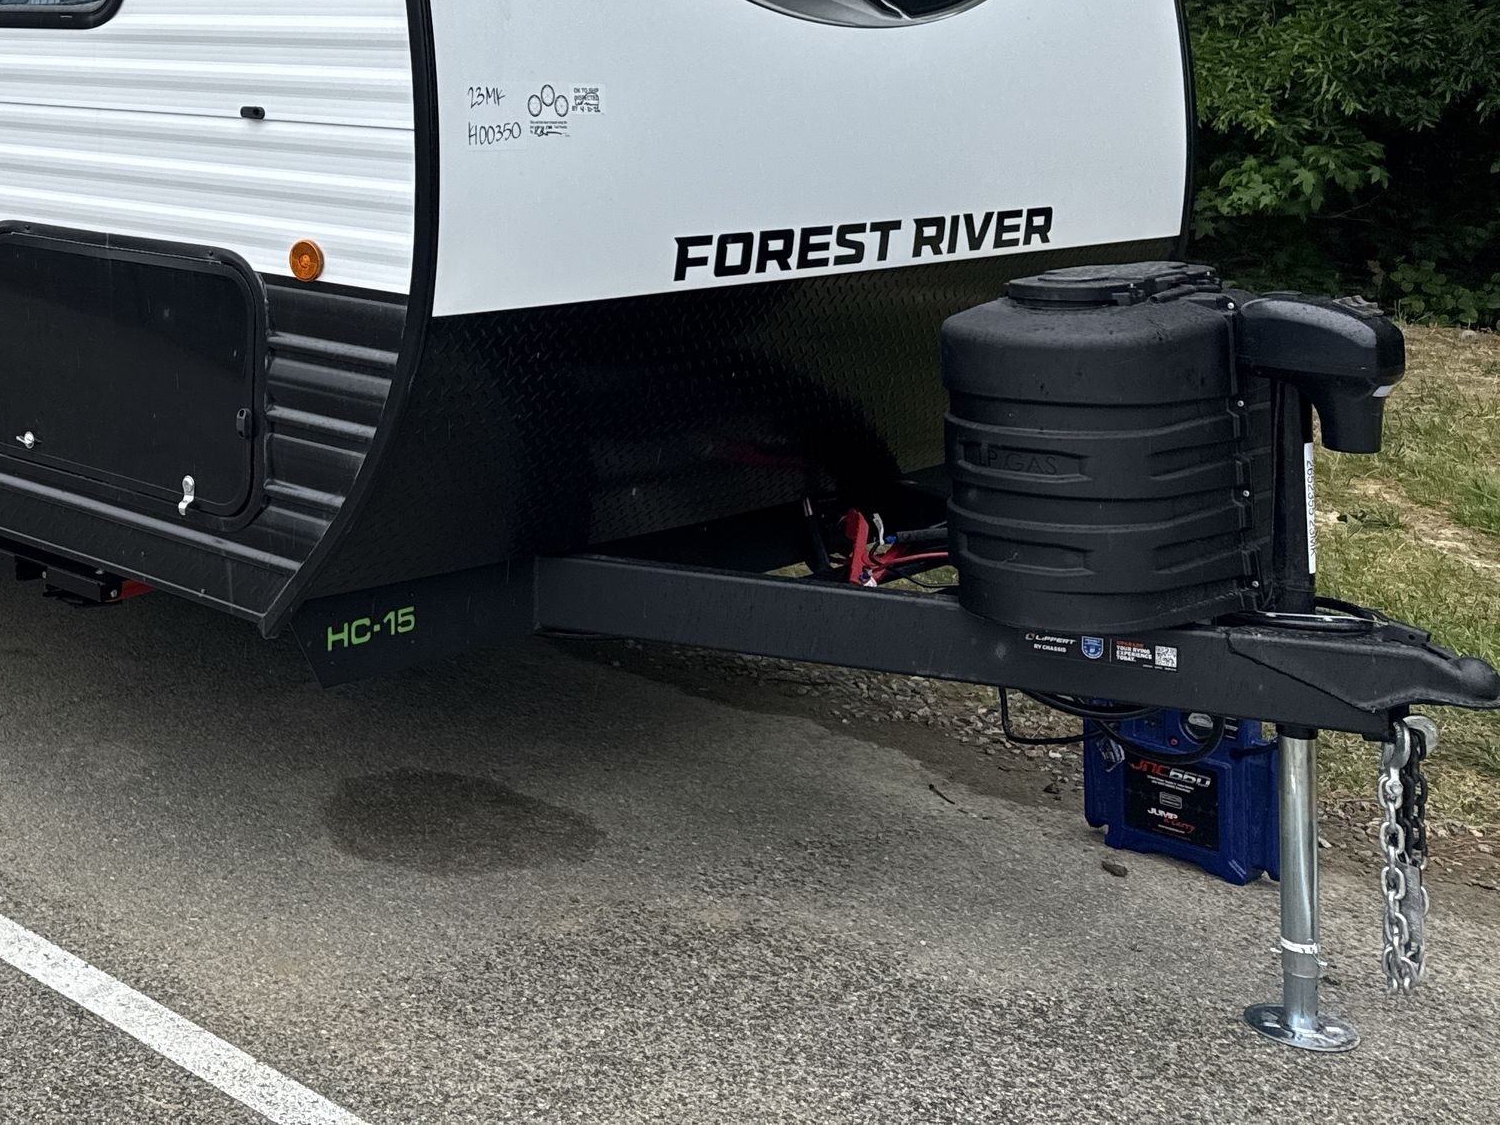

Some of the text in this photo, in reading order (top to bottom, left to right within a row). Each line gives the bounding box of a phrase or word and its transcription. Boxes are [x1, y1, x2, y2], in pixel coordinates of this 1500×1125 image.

[673, 206, 1053, 282] FOREST RIVER
[1002, 452, 1058, 475] GAS
